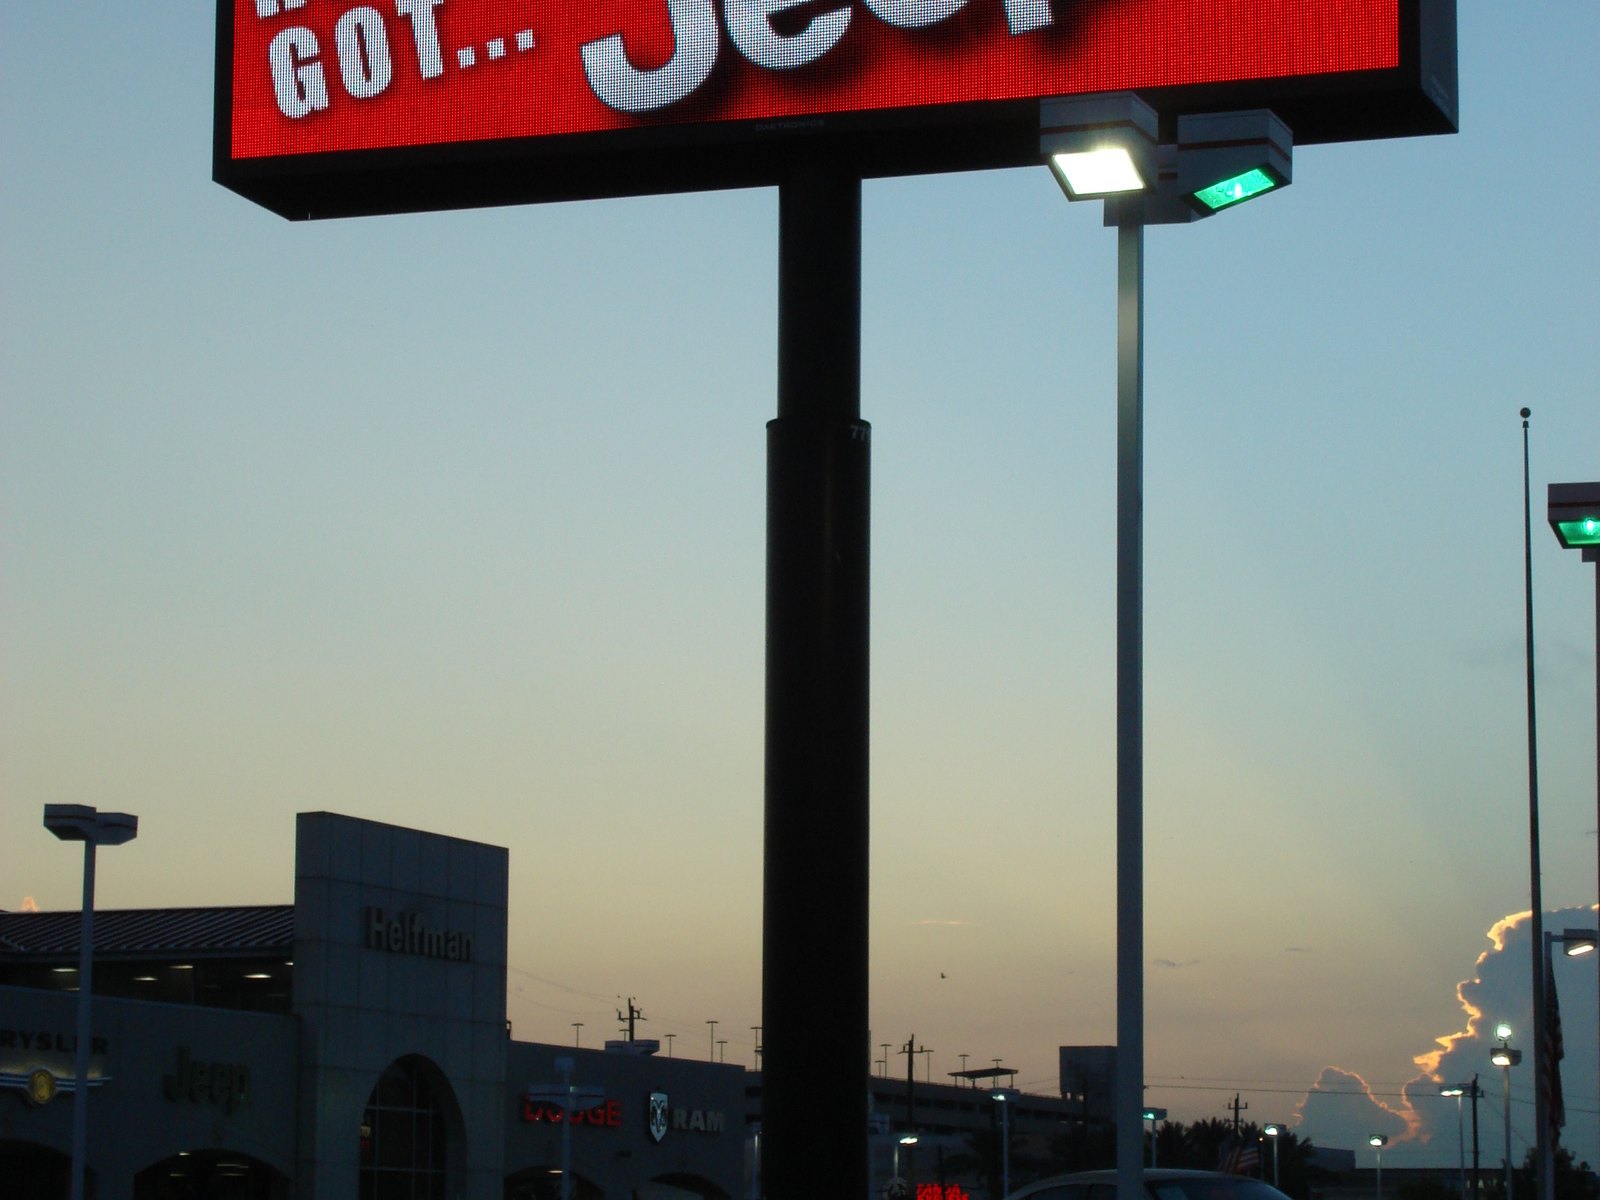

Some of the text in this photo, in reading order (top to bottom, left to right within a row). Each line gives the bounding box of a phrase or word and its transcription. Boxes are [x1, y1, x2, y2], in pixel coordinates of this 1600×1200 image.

[366, 906, 474, 963] Helfman
[0, 1030, 108, 1054] RYSLR
[162, 1046, 250, 1117] Jeep
[672, 1107, 725, 1134] RAM
